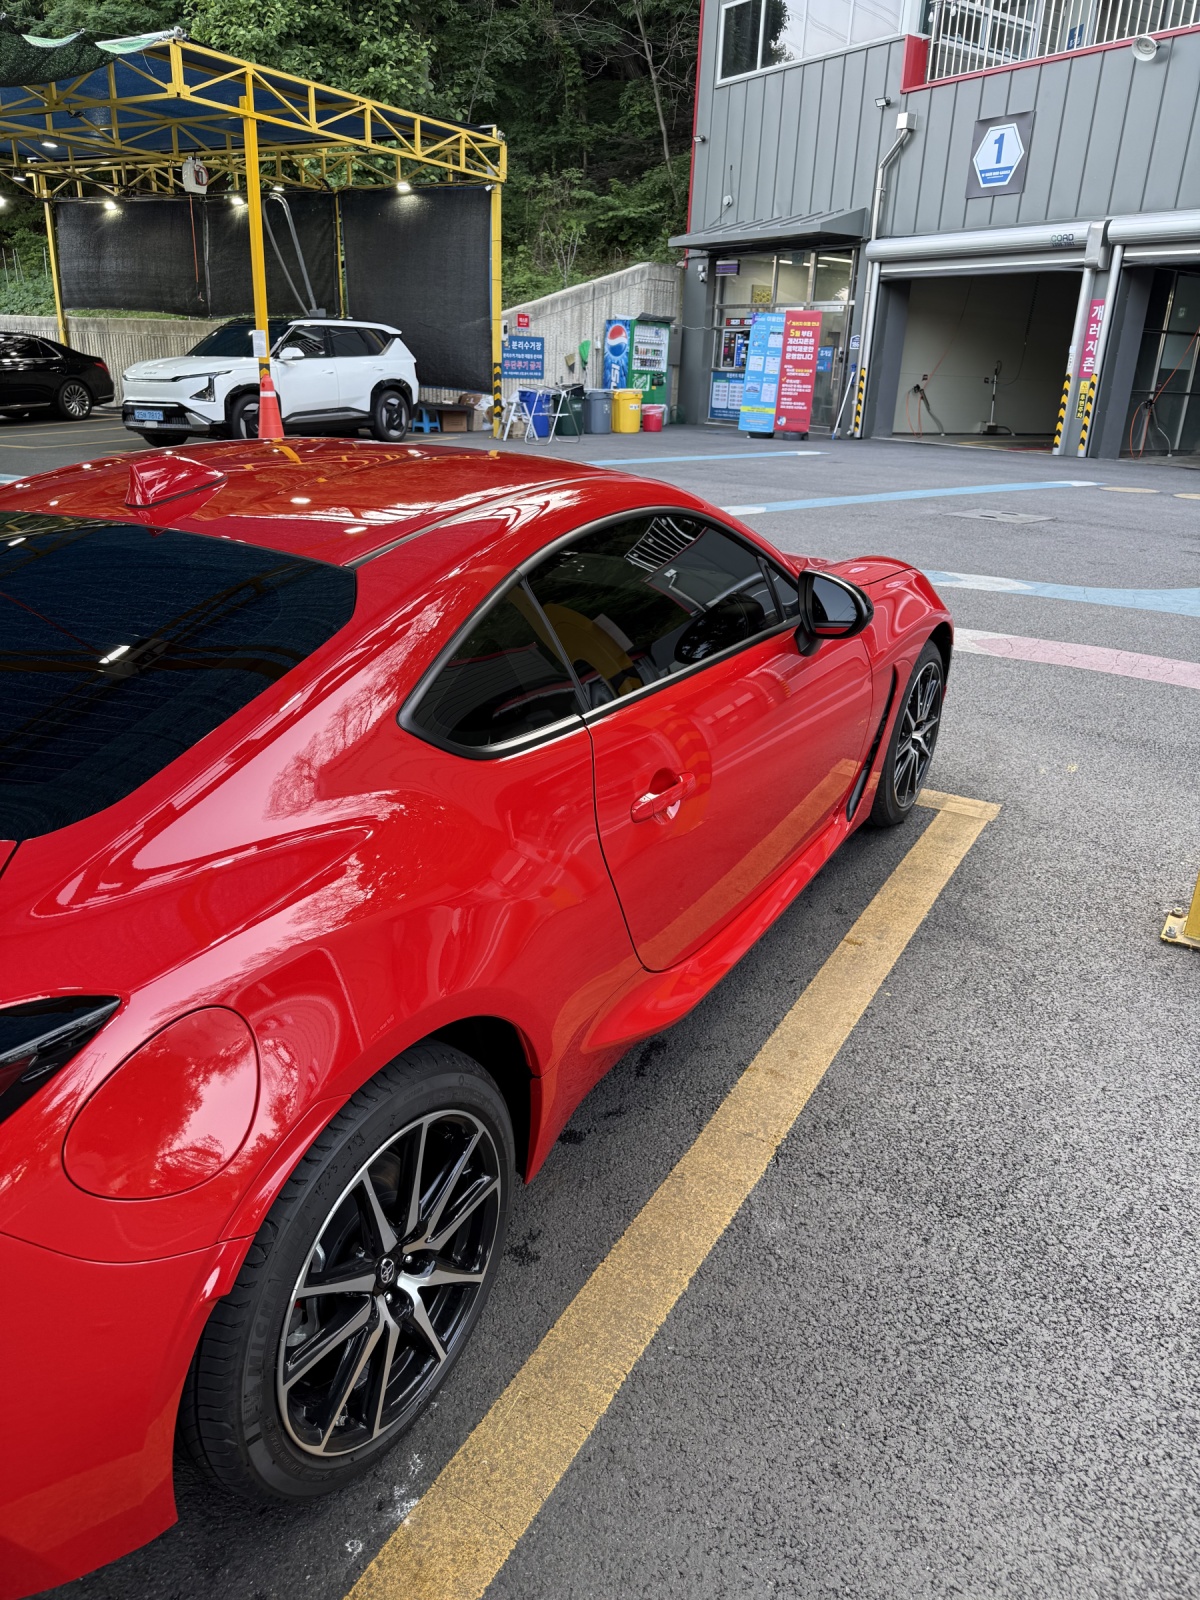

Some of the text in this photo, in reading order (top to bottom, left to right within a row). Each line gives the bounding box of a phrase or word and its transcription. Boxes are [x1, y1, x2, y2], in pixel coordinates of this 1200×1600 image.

[994, 133, 1005, 164] 1
[1051, 233, 1074, 242] COAD
[790, 328, 801, 337] 5월
[1082, 305, 1104, 373] 개러지존
[511, 340, 542, 350] 분리수거장
[785, 353, 814, 361] 운영합니다
[504, 360, 542, 371] 무단투기 금지
